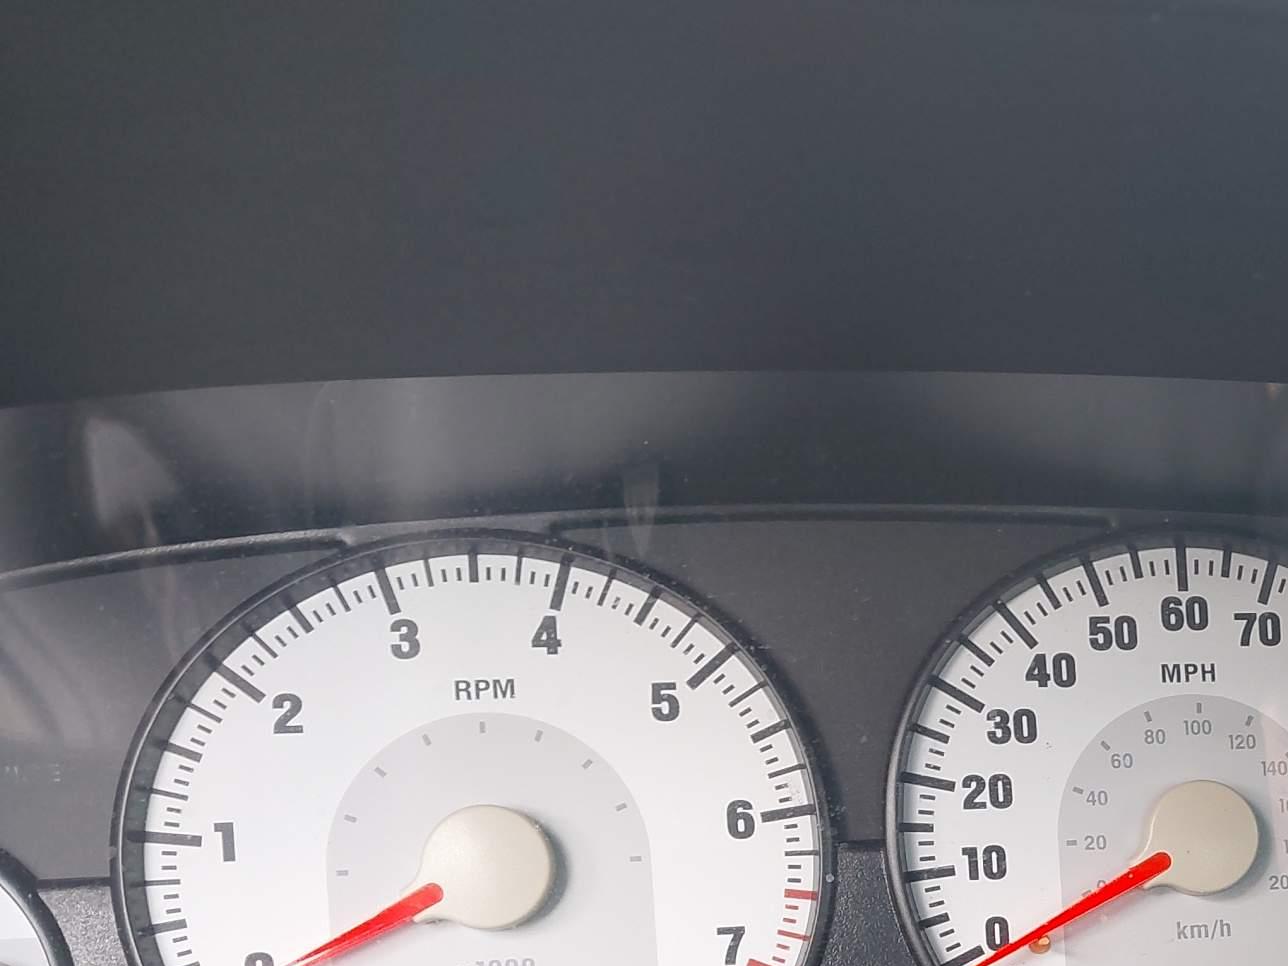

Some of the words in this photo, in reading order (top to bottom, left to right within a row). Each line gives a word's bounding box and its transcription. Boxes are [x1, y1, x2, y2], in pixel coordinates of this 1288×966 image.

[1160, 595, 1209, 632] 60
[1233, 611, 1283, 647] 70
[389, 617, 422, 660] 3
[531, 615, 563, 656] 4
[1087, 615, 1138, 652] 50
[1025, 652, 1077, 689] 40
[1160, 662, 1217, 684] MPH
[453, 677, 517, 702] RPM
[650, 682, 681, 723] 5
[271, 692, 305, 736] 2
[984, 708, 1039, 744] 30
[1182, 718, 1213, 737] 100
[1143, 727, 1167, 746] 80
[1227, 733, 1258, 750] 120
[1109, 752, 1134, 770] 60
[1260, 759, 1288, 777] 140
[961, 773, 1014, 810] 20
[1085, 790, 1109, 807] 40
[725, 799, 757, 841] 6
[213, 820, 237, 864] 1
[1083, 834, 1108, 852] 20
[960, 844, 1008, 882] 10
[716, 926, 748, 966] 7
[984, 916, 1011, 953] 0
[1175, 918, 1233, 942] km/h
